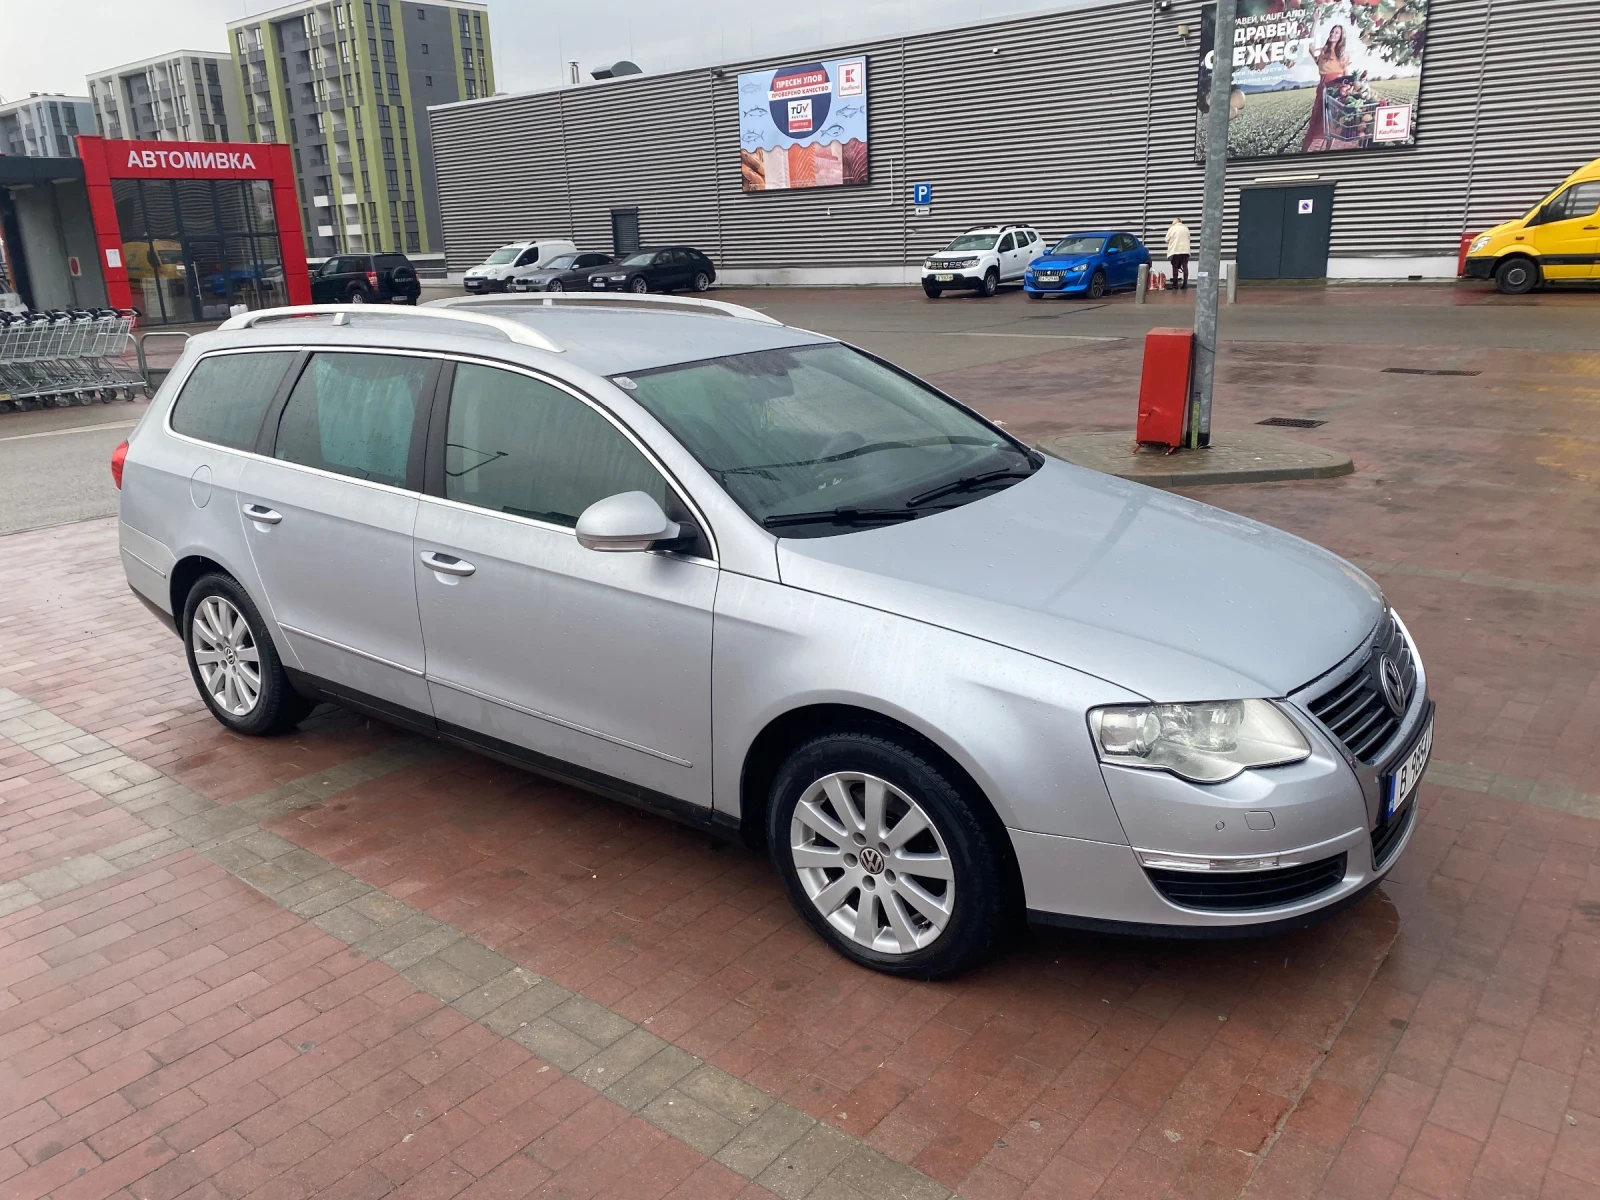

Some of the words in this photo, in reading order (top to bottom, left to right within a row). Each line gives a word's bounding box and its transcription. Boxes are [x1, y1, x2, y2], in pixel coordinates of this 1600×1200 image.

[1234, 18, 1300, 45] ДРАВЕЙ,
[776, 78, 802, 88] ПРЕСЕН
[803, 74, 822, 84] УЛОВ
[772, 89, 801, 98] ПРОВЕРЕНО
[802, 86, 829, 95] КАЧЕСТВО
[127, 150, 256, 170] АВТОМИВКА
[918, 185, 928, 201] P
